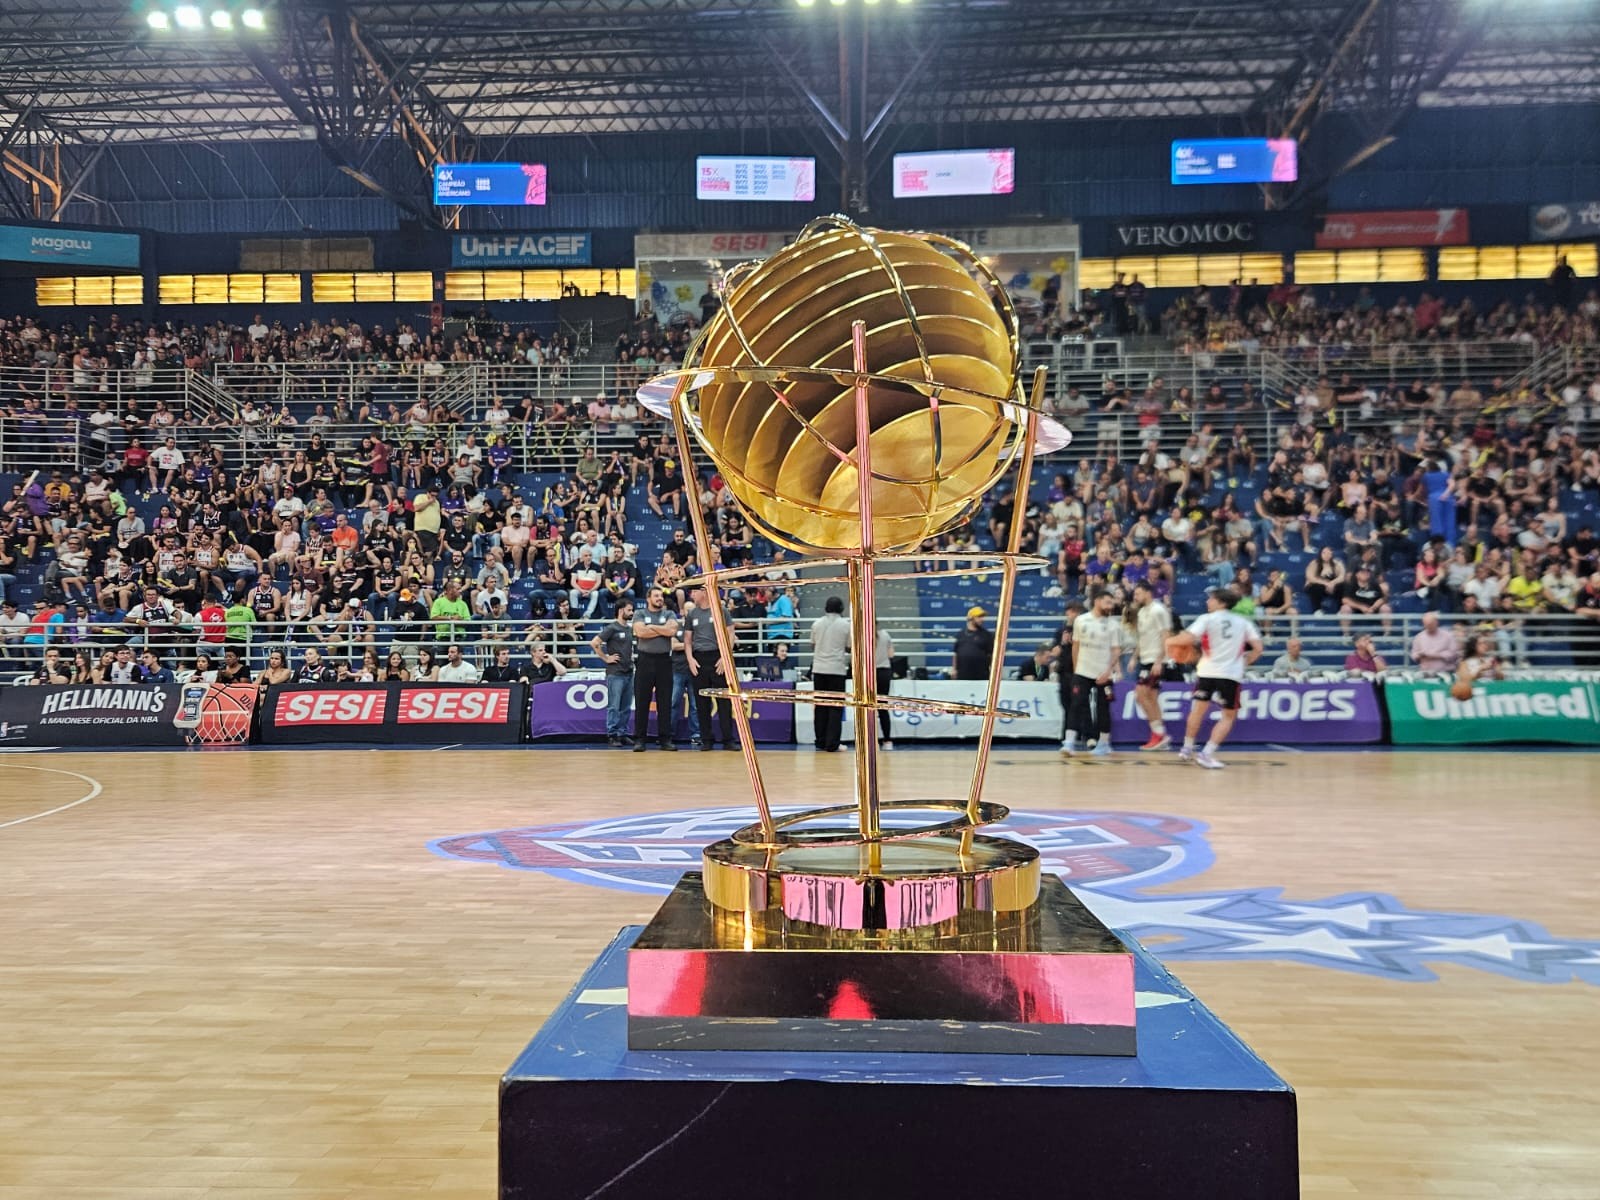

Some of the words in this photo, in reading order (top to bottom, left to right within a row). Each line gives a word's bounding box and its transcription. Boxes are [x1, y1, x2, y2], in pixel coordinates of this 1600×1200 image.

[711, 234, 769, 250] SESI
[1118, 222, 1254, 247] VEROMOC
[1220, 620, 1232, 639] 2
[41, 686, 167, 715] HELLMANN'S
[284, 694, 377, 721] SESI
[408, 692, 500, 719] SESI
[1412, 686, 1591, 720] Unimed
[39, 717, 47, 725] A
[47, 716, 92, 725] MAIONESE
[92, 716, 125, 725] OFICIAL
[126, 715, 139, 724] DA
[140, 715, 159, 723] NBA
